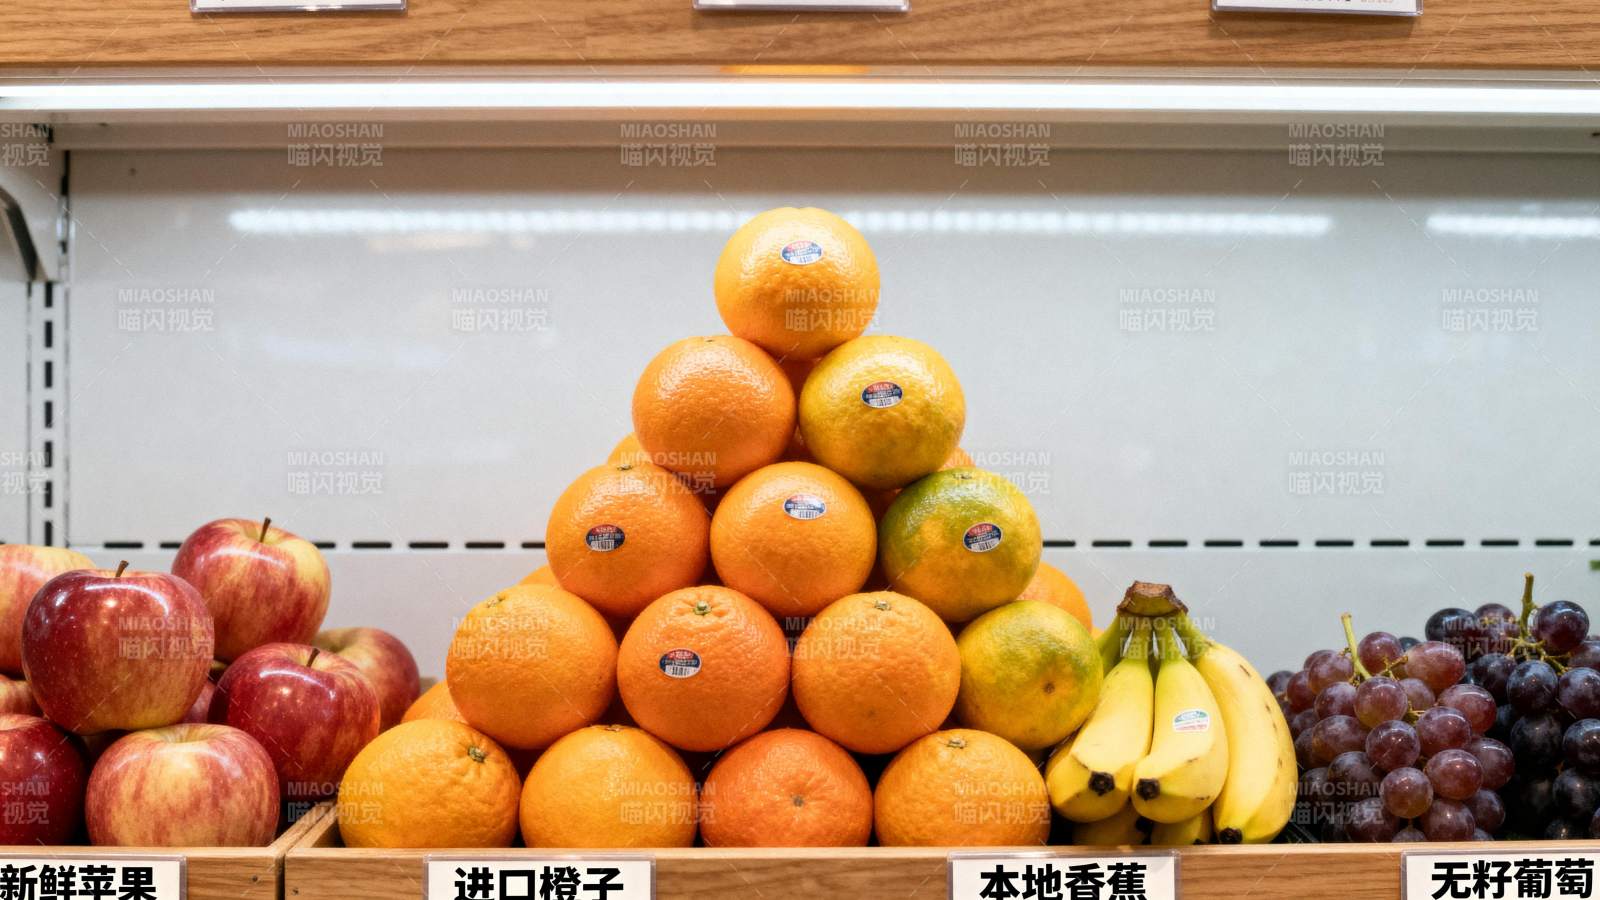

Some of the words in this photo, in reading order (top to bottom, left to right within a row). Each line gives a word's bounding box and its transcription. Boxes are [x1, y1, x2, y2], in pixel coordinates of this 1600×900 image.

[0, 864, 157, 900] 新鲜苹果
[454, 866, 624, 900] 进口橙子
[980, 863, 1148, 900] 本地香蕉
[1431, 858, 1594, 900] 无籽葡萄
